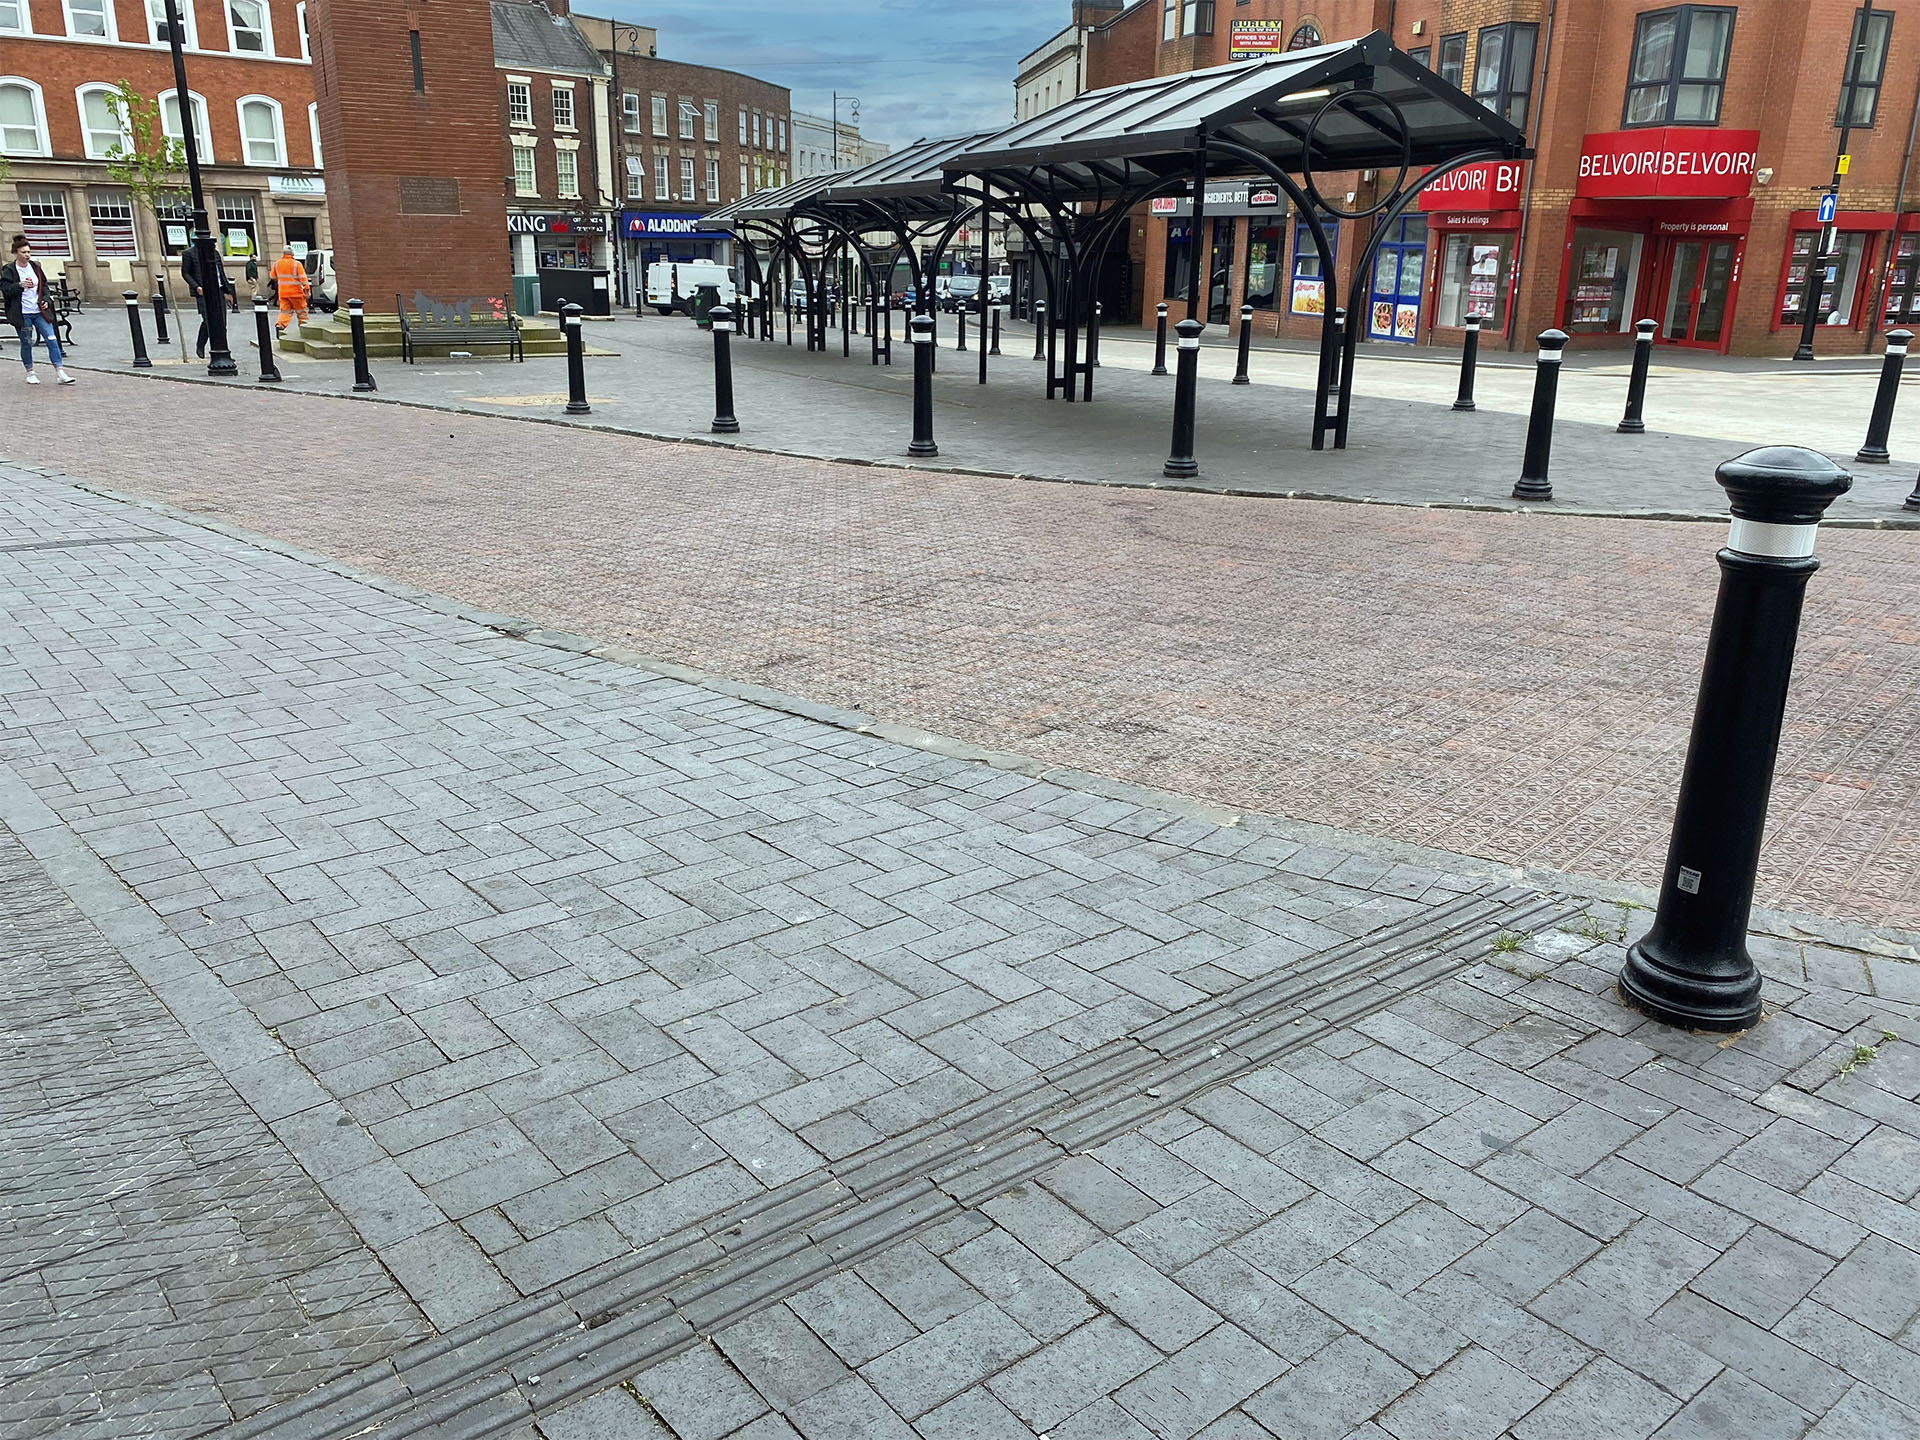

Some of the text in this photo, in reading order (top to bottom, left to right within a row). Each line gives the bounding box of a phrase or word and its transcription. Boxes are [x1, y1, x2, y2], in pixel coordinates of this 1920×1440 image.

[1579, 151, 1661, 177] BELVOIR!
[1661, 152, 1757, 176] BELVOIR!
[1496, 165, 1521, 192] B!
[506, 215, 546, 232] KING
[1447, 215, 1461, 224] Sales
[1467, 216, 1489, 226] Lettings
[1660, 221, 1729, 233] Property is personal
